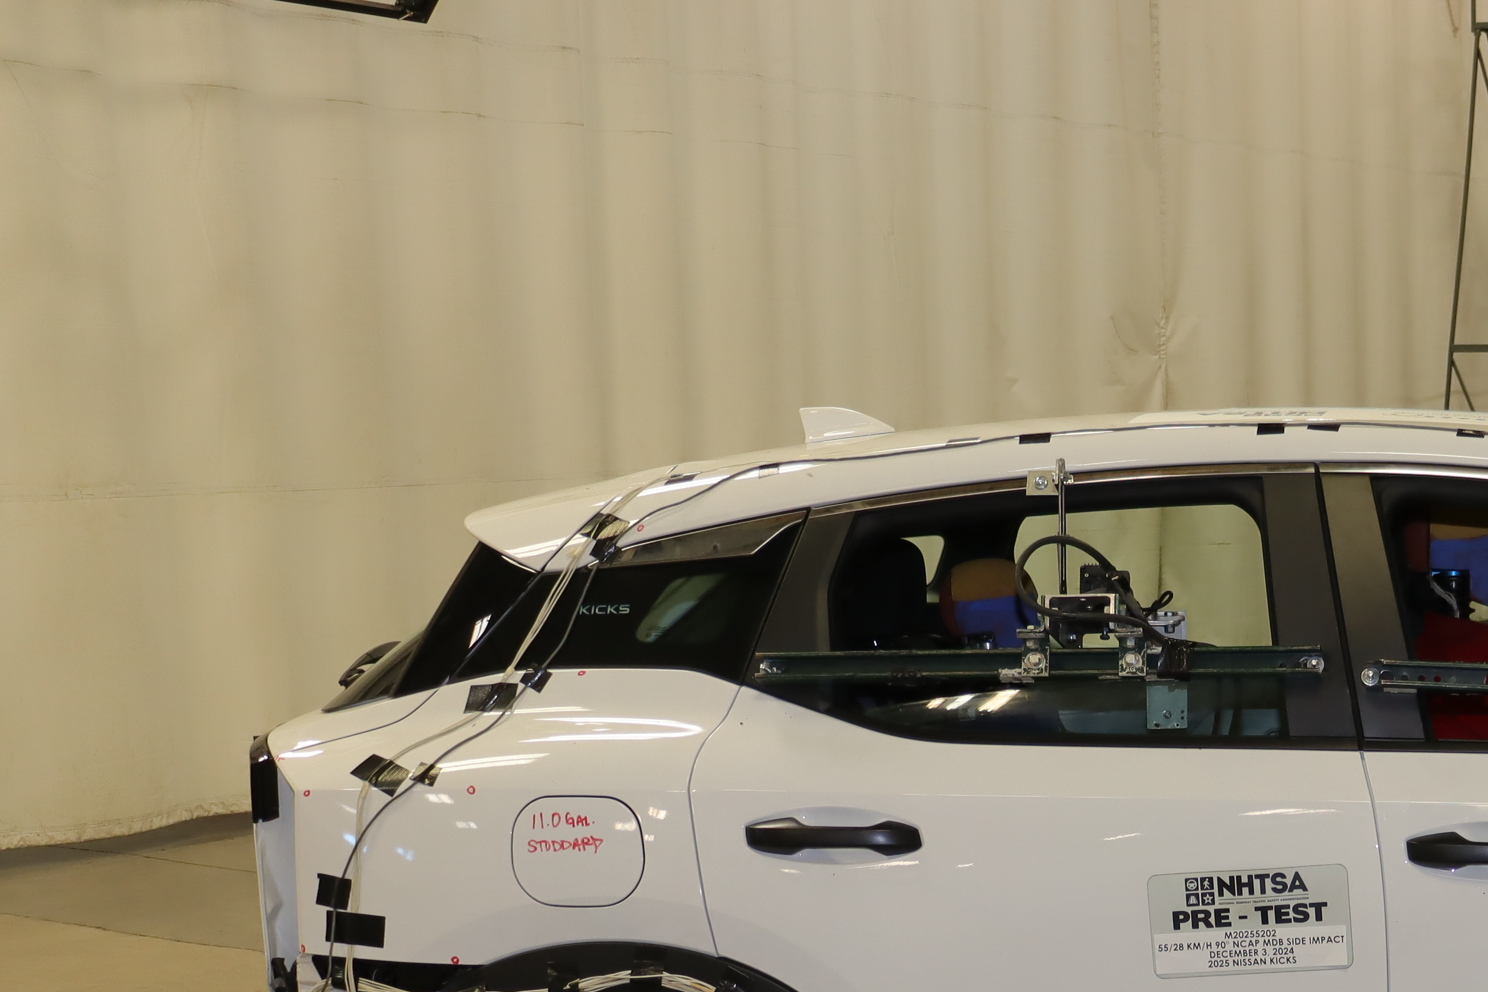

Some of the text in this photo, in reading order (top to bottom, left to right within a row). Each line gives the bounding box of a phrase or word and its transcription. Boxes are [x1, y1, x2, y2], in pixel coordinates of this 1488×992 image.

[579, 604, 631, 615] KICKS
[532, 812, 561, 829] 11.0
[1217, 871, 1308, 897] NHTSA
[1172, 908, 1232, 930] PRE
[1254, 902, 1328, 925] TEST
[1224, 929, 1277, 939] M20255202
[1158, 943, 1184, 953] 55/28
[1186, 941, 1212, 951] KM/H
[1232, 938, 1260, 948] NCAP
[1263, 938, 1284, 947] MDB
[1287, 936, 1306, 946] SIDE
[1309, 935, 1345, 944] IMPACT
[1209, 946, 1294, 959] DECEMBER 3, 2024
[1208, 955, 1297, 968] 2025 NISSAN KICKS
